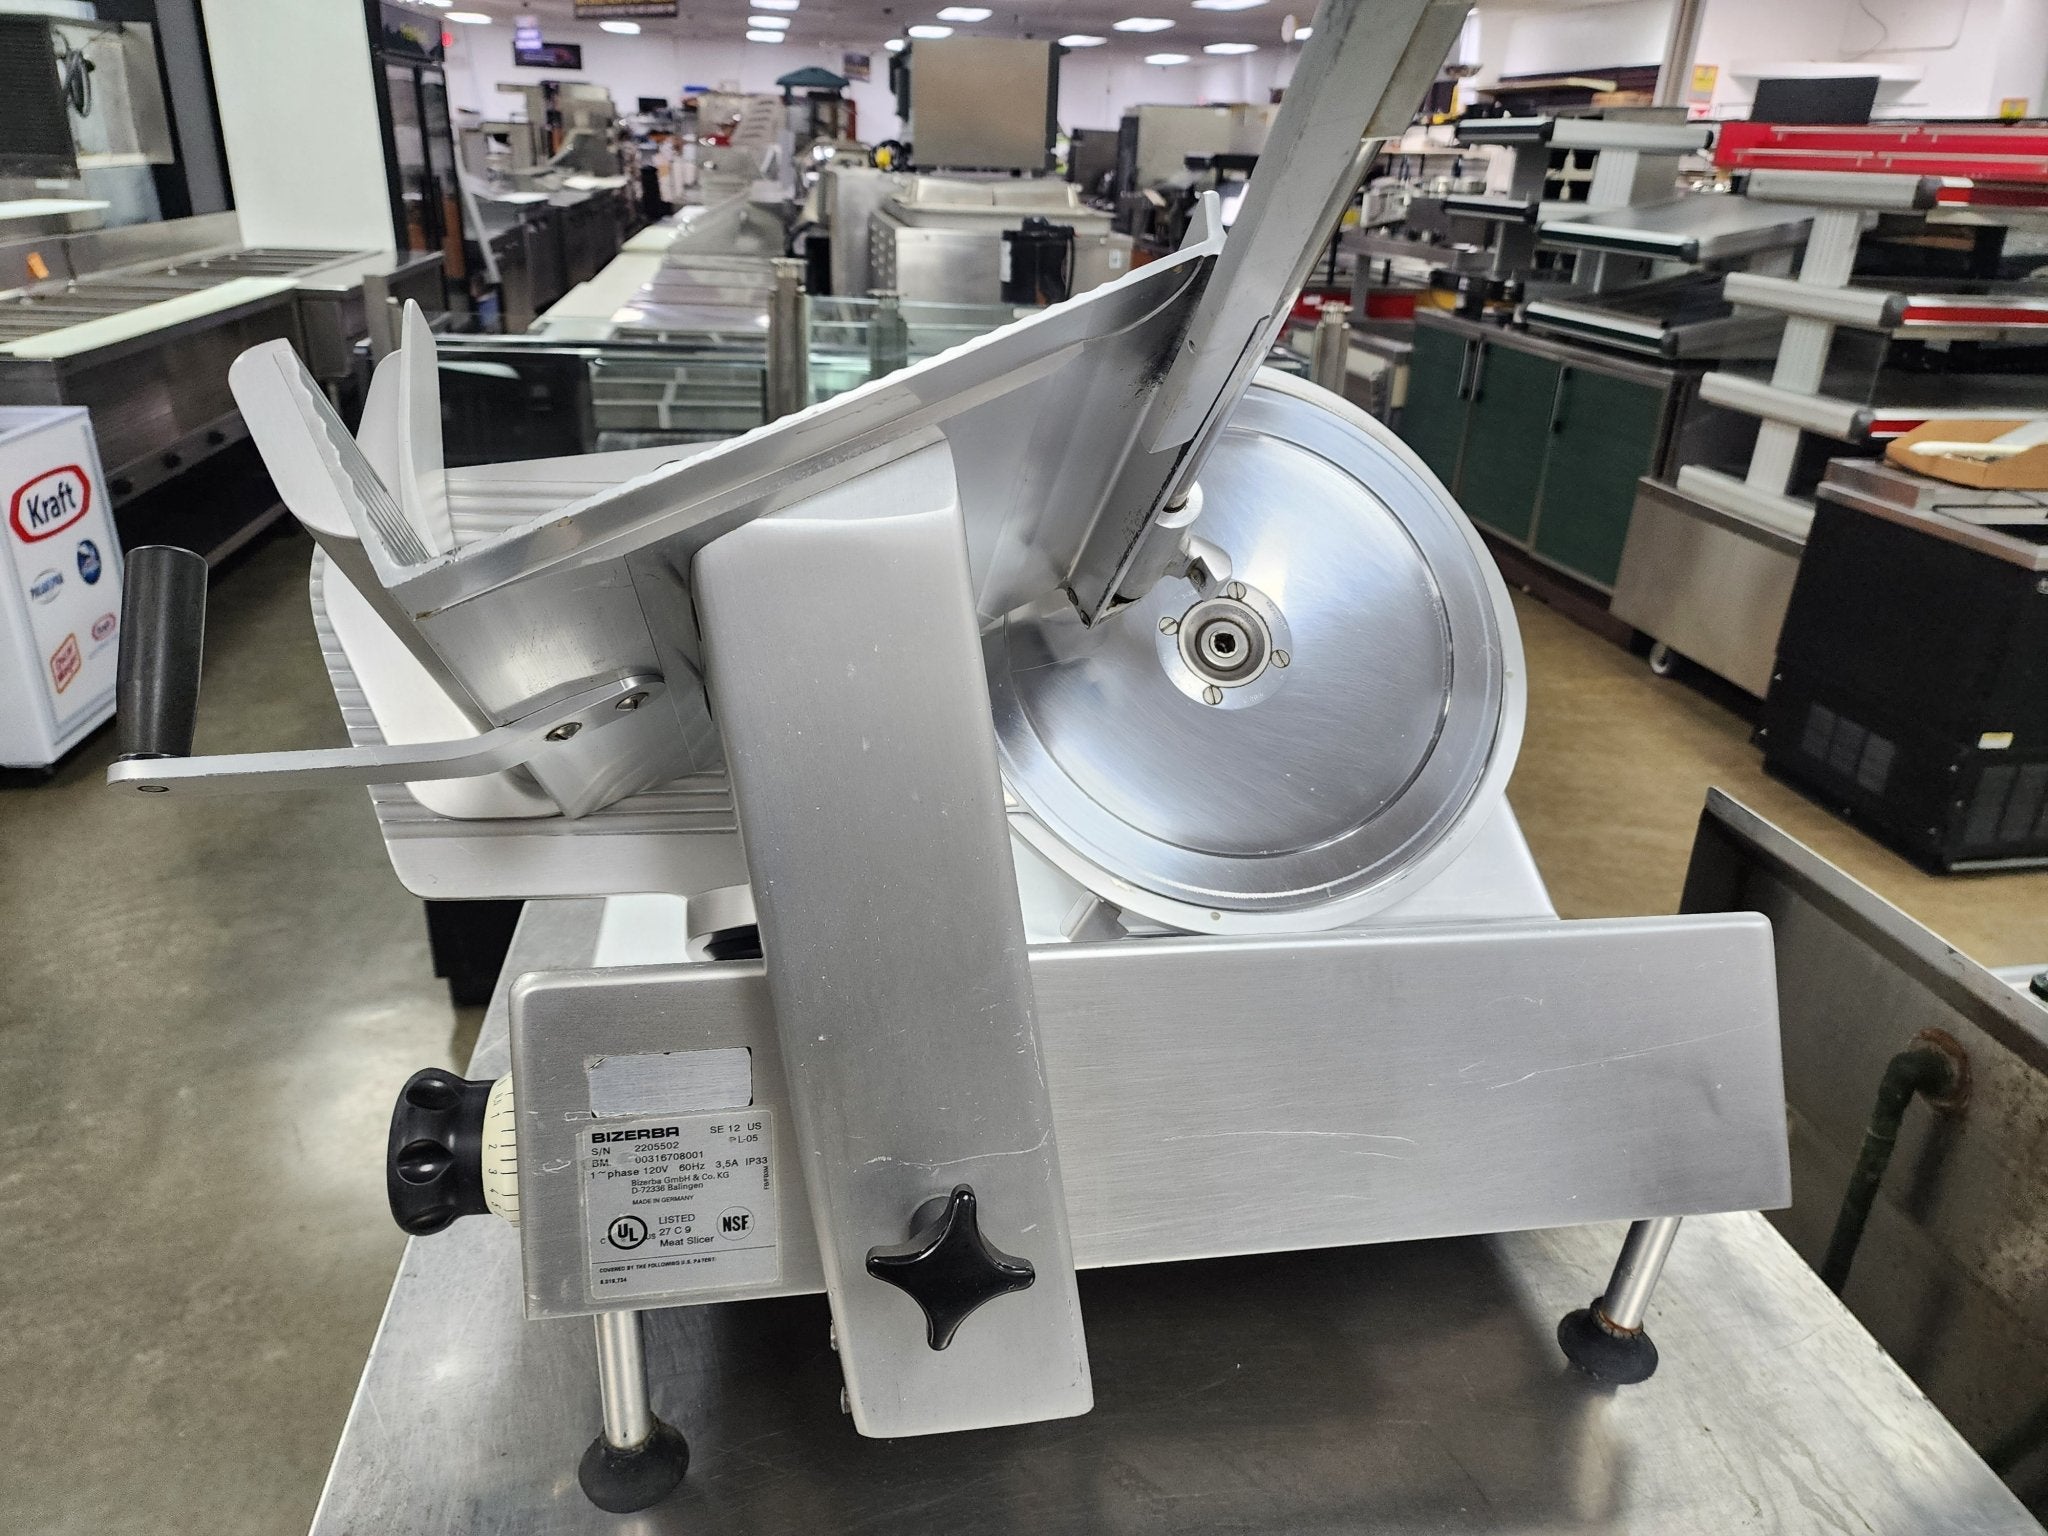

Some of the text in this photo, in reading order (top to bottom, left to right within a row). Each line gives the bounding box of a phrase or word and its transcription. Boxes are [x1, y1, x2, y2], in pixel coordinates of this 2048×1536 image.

[26, 480, 76, 529] Kraft
[591, 1126, 680, 1144] BIZERBA
[710, 1122, 762, 1134] SE 12 US
[591, 1141, 680, 1156] S/N 2205502
[607, 1169, 640, 1180] phase
[643, 1165, 669, 1175] 120V
[679, 1162, 706, 1172] 60Hz
[715, 1159, 739, 1169] 3,5A
[745, 1156, 768, 1166] IP33
[631, 1178, 662, 1187] Bizerba
[664, 1175, 691, 1184] GmbH
[701, 1173, 716, 1181] Co.
[717, 1171, 730, 1179] KG
[667, 1182, 704, 1191] Balingen
[661, 1194, 694, 1203] GERMANY
[658, 1213, 696, 1225] LISTED
[722, 1214, 749, 1233] NSF
[659, 1225, 692, 1237] 27 C 9
[659, 1234, 715, 1248] Meat Slicer
